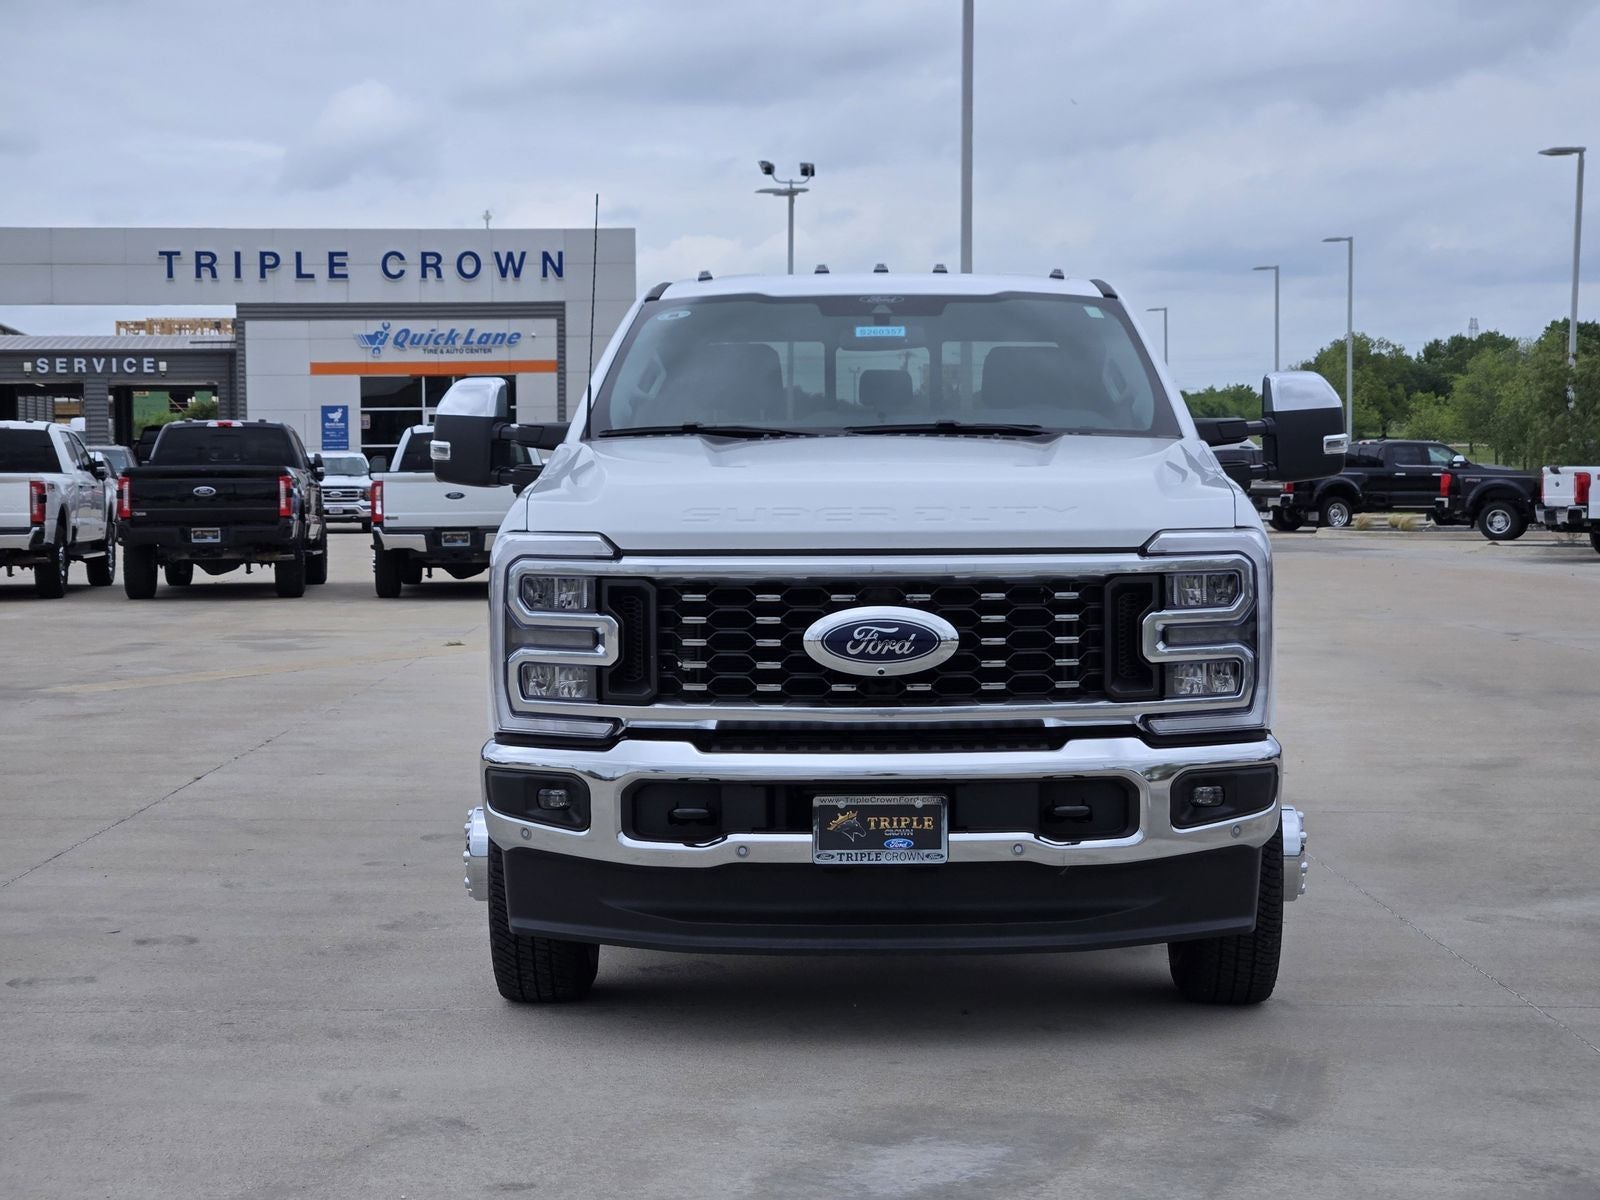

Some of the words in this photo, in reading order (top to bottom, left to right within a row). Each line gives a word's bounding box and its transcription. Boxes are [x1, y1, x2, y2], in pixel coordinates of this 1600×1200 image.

[158, 250, 349, 279] TRIPLE
[381, 250, 564, 280] CROWN
[393, 328, 459, 349] Quick
[463, 328, 522, 346] Lane
[36, 357, 155, 373] SERVICE
[681, 505, 898, 525] SUPER
[912, 504, 1080, 524] DUTY
[846, 625, 916, 655] Ford
[867, 816, 934, 830] TRIPLE
[837, 852, 881, 861] TRIPLE
[884, 852, 925, 861] CROWN
